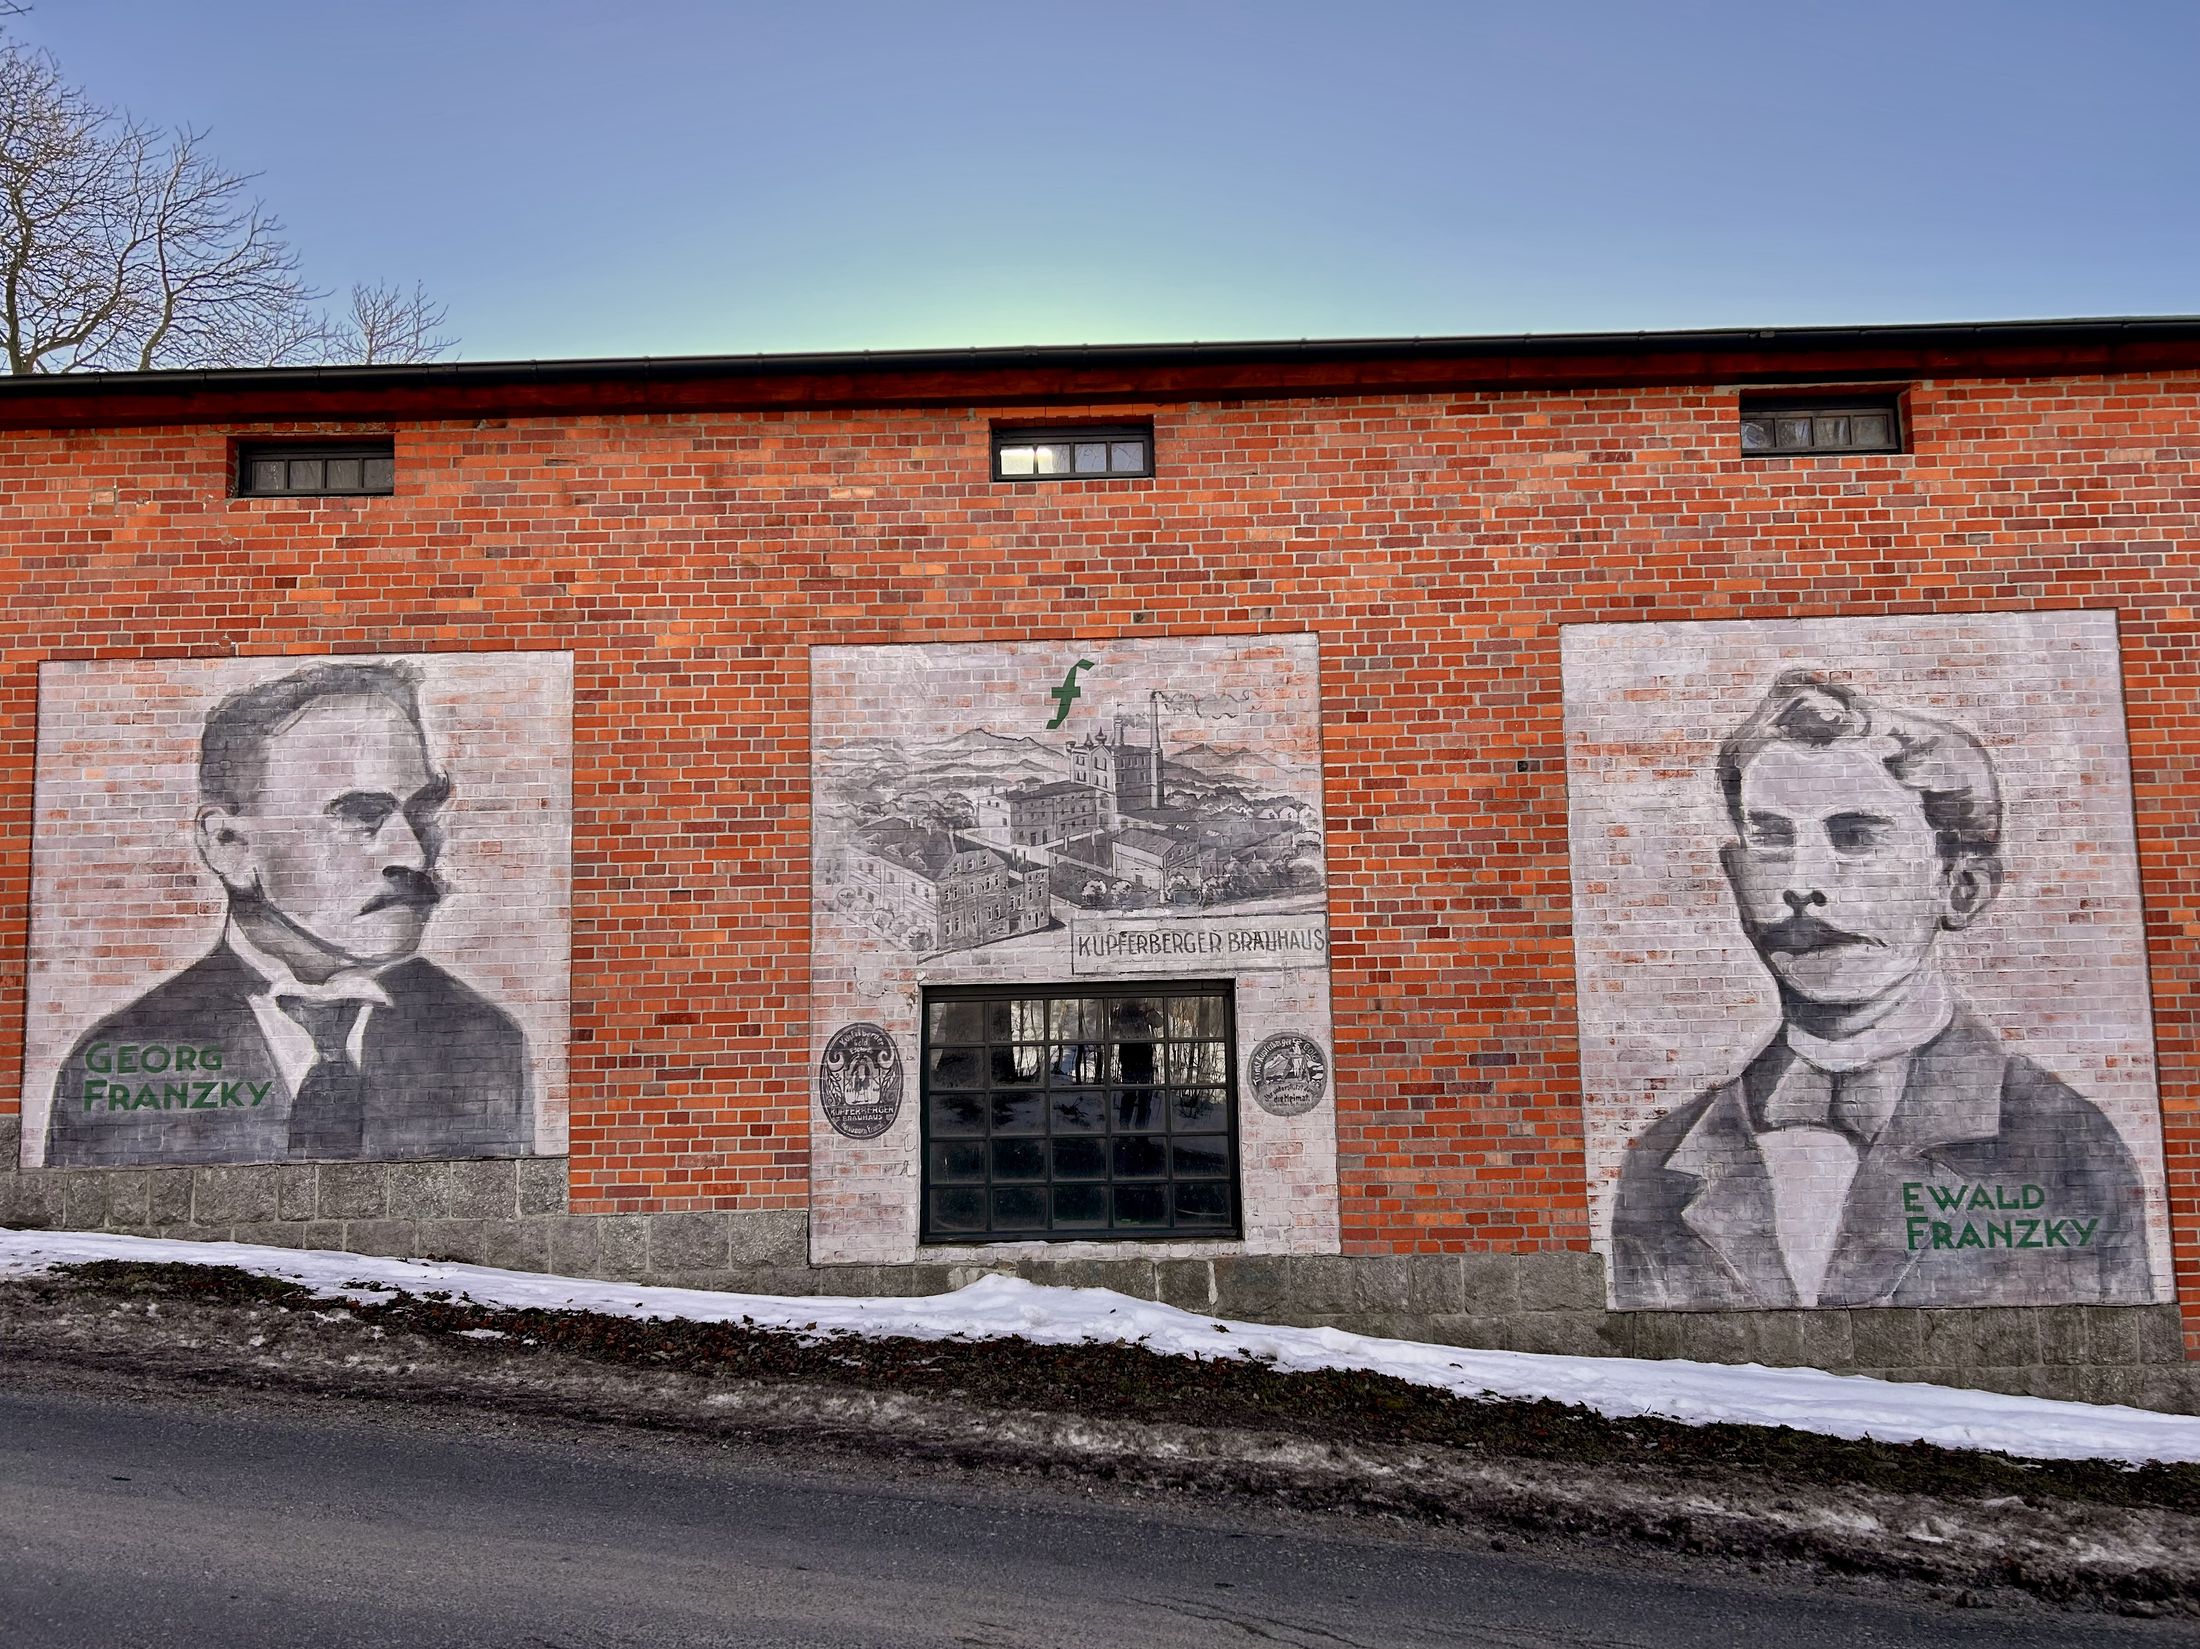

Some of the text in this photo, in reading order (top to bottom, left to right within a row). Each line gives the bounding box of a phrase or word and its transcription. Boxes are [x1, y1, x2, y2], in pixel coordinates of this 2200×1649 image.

[1078, 928, 1326, 956] KUPFERBERGER BRAUHAUS
[85, 1042, 223, 1074] GEORG
[1303, 1042, 1320, 1062] Gold
[83, 1079, 273, 1112] FRANZKY
[1902, 1182, 2046, 1212] EWALD
[1906, 1217, 2099, 1250] FRANZKY
